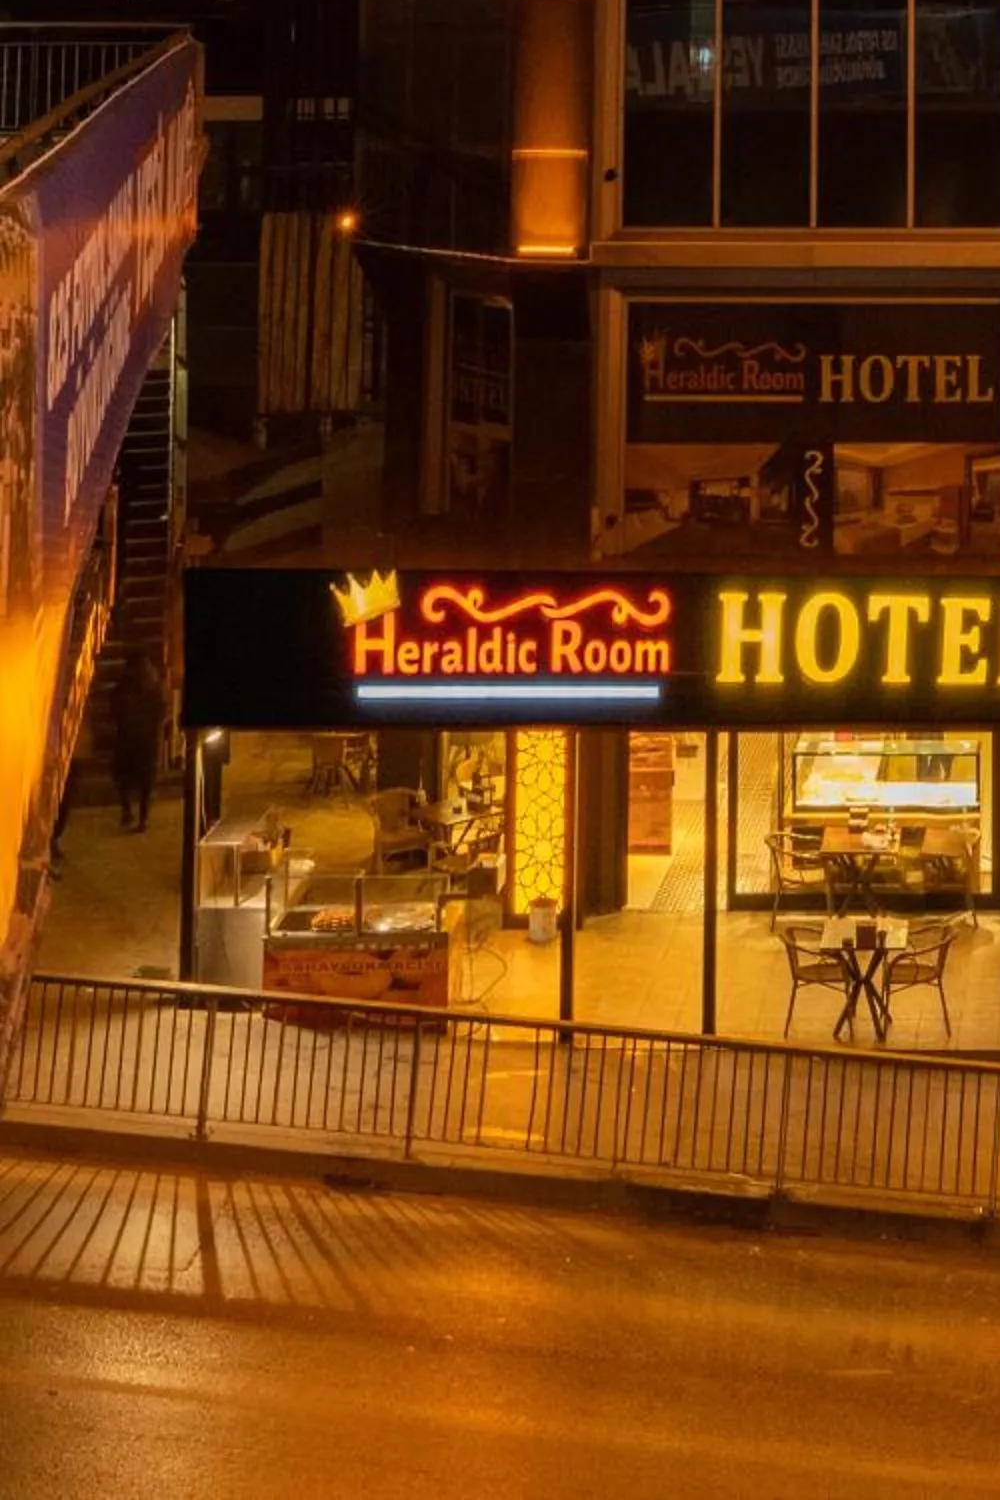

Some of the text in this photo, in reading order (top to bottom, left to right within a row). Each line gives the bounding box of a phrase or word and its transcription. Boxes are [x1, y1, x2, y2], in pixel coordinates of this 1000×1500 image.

[644, 354, 994, 403] Heraldic Room HOTEL
[354, 611, 537, 675] Heraldic
[551, 619, 671, 674] Room
